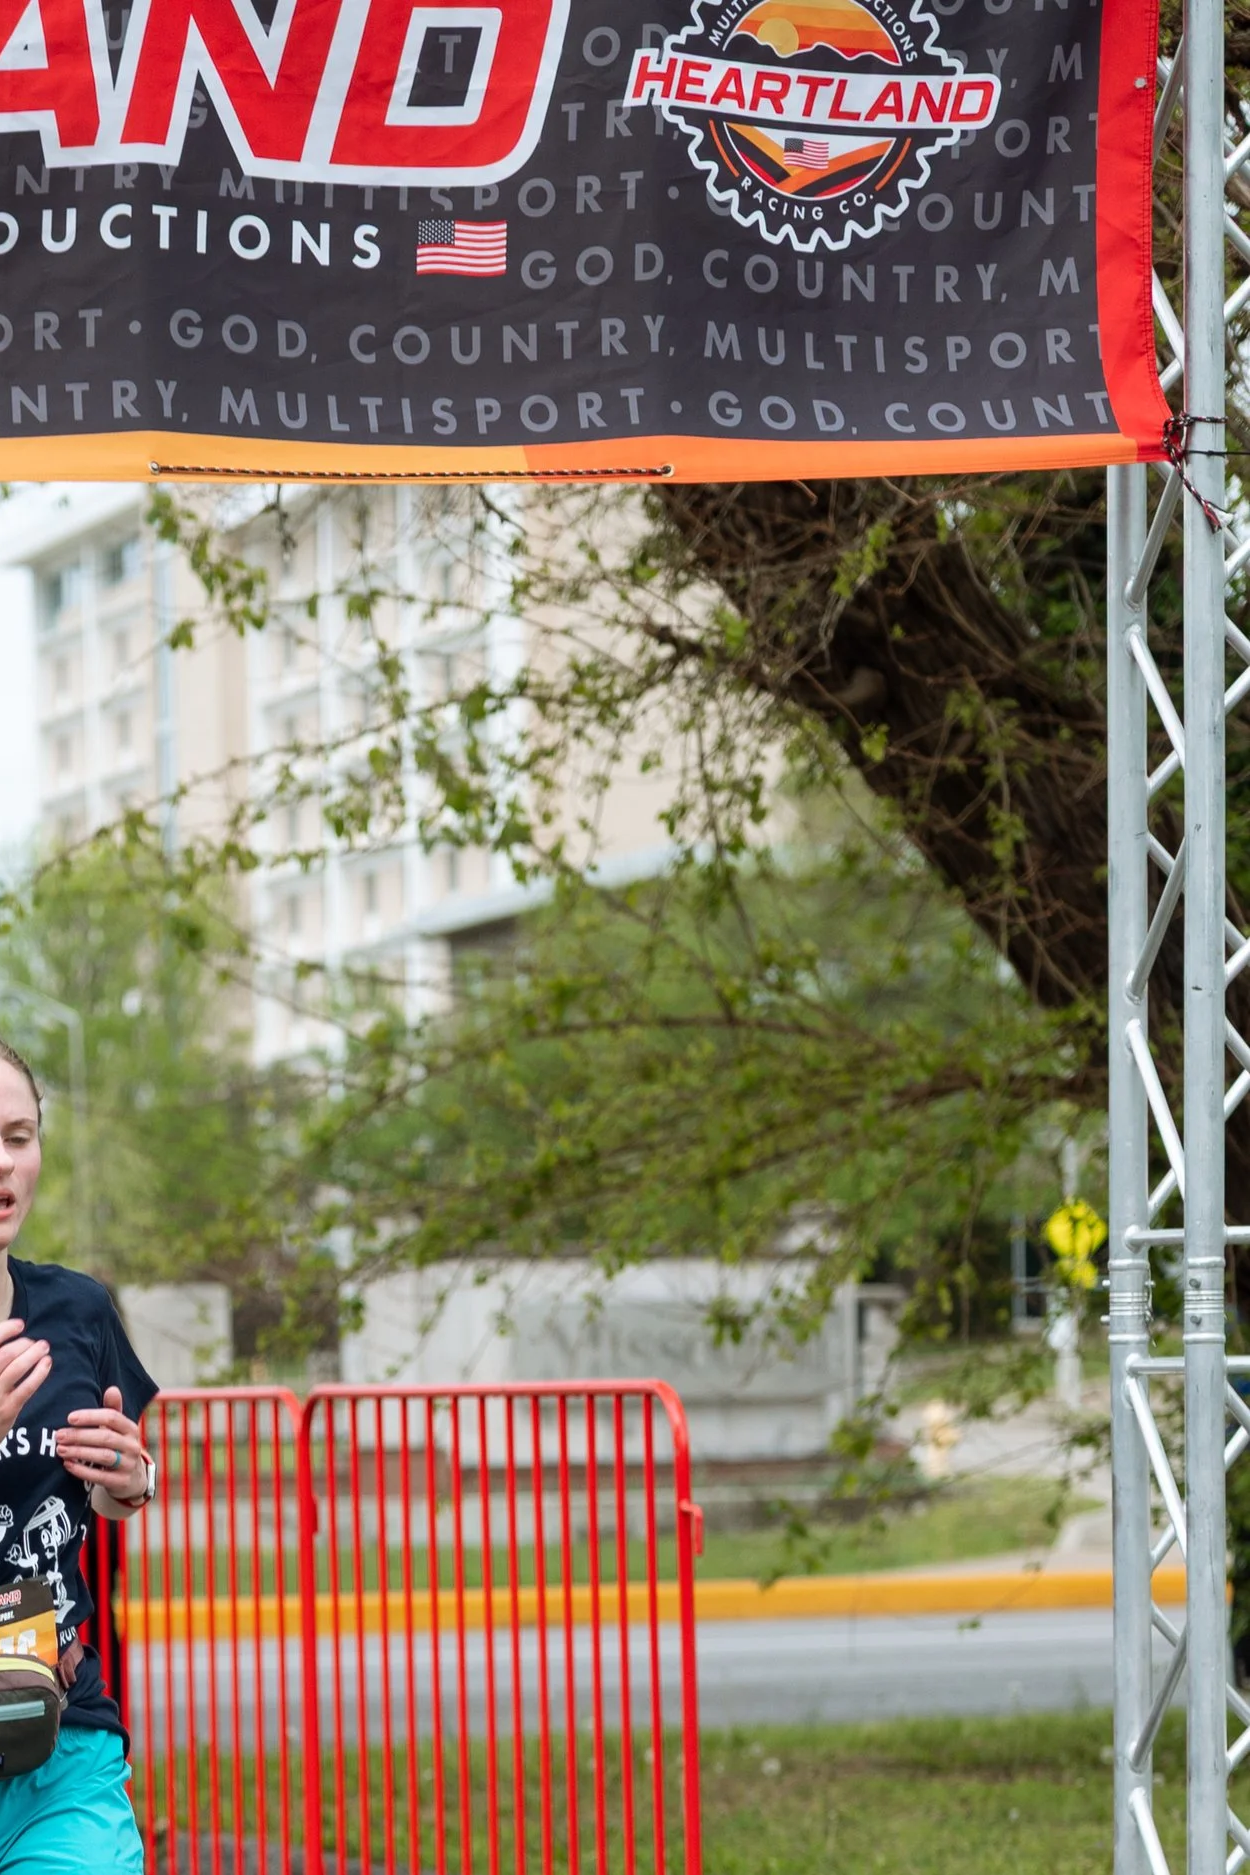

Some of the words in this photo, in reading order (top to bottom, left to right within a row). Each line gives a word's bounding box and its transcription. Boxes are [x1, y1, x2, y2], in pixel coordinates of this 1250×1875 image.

[630, 53, 997, 125] HEARTLAND
[740, 175, 824, 221] RACING
[839, 191, 874, 215] CO.
[521, 243, 674, 290] GOD,
[702, 249, 1007, 302] COUNTRY,
[169, 308, 317, 364] GOD,
[349, 315, 675, 365] COUNTRY,
[219, 385, 644, 435] MULTISPORT
[708, 390, 858, 435] GOD,
